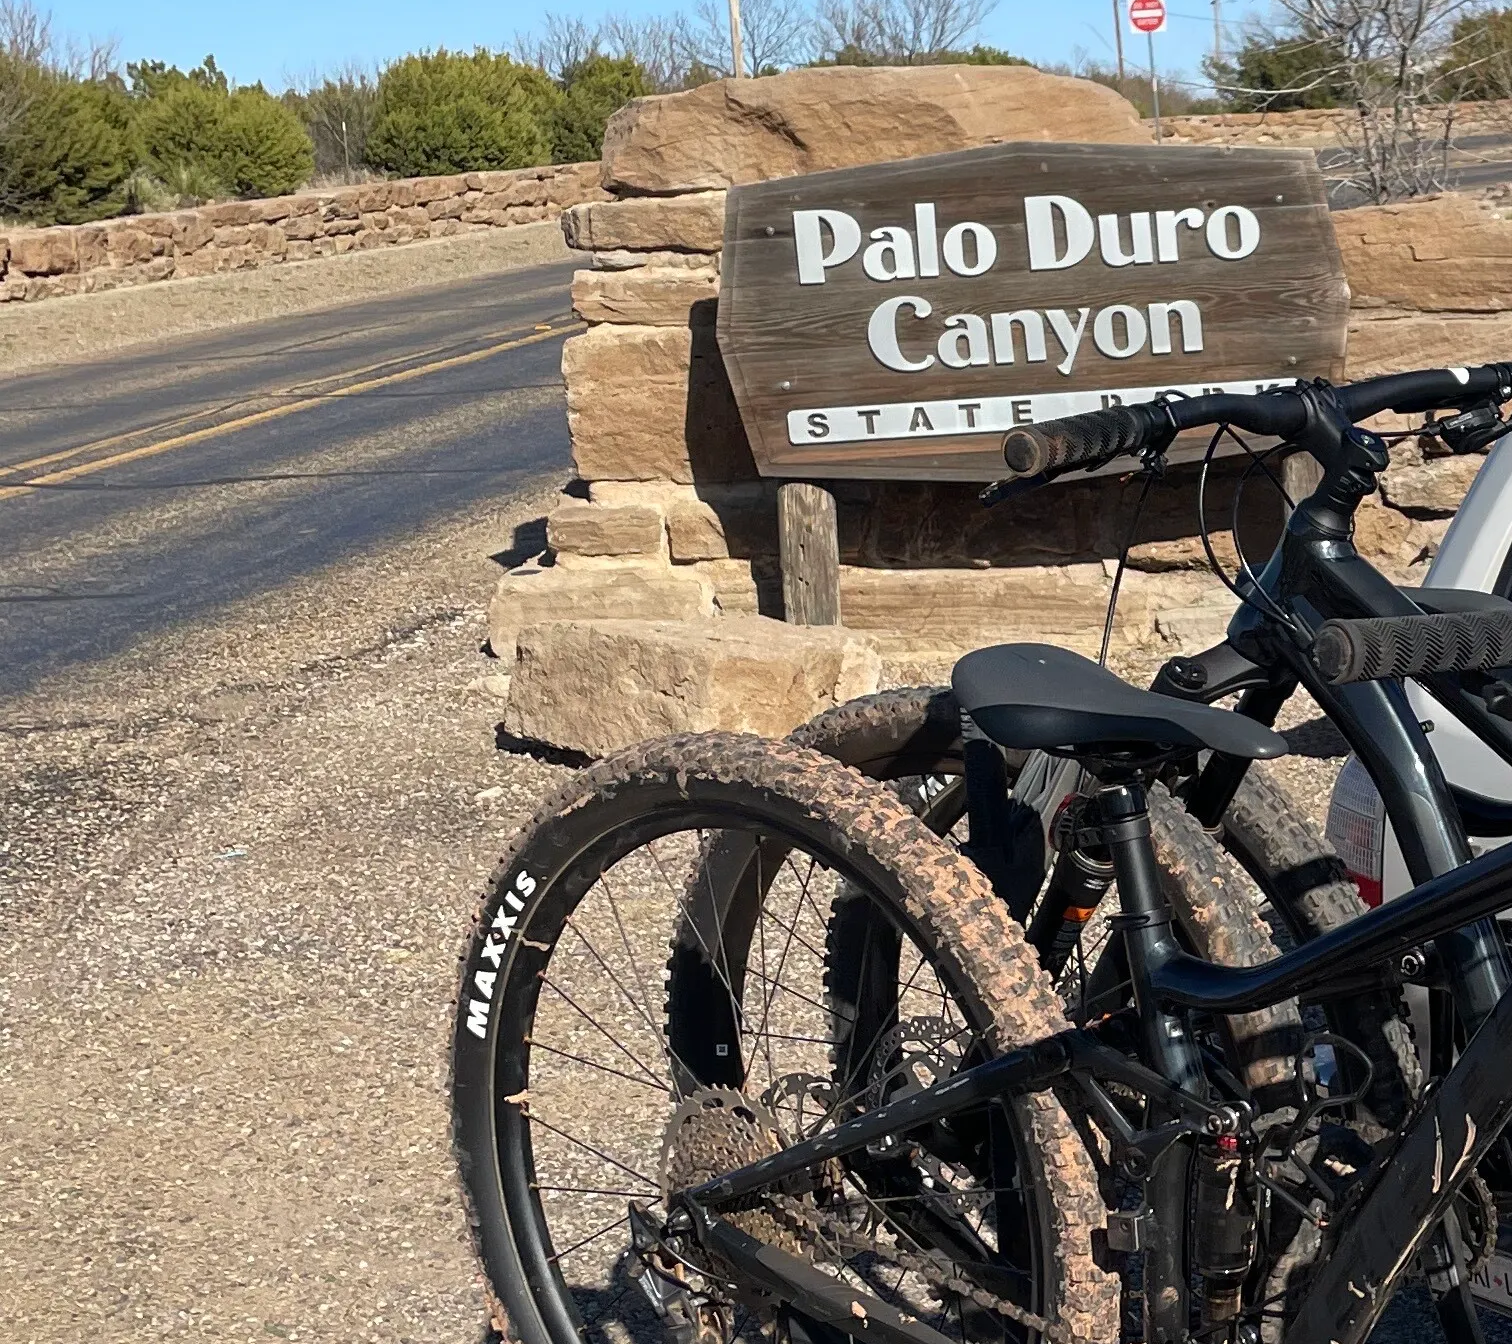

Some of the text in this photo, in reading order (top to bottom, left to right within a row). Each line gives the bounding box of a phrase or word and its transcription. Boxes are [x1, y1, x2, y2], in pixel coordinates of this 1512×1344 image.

[792, 194, 1262, 285] Palo Duro
[866, 295, 1205, 376] Canyon
[806, 399, 1034, 439] STATE
[466, 870, 537, 1040] MAXXIS
